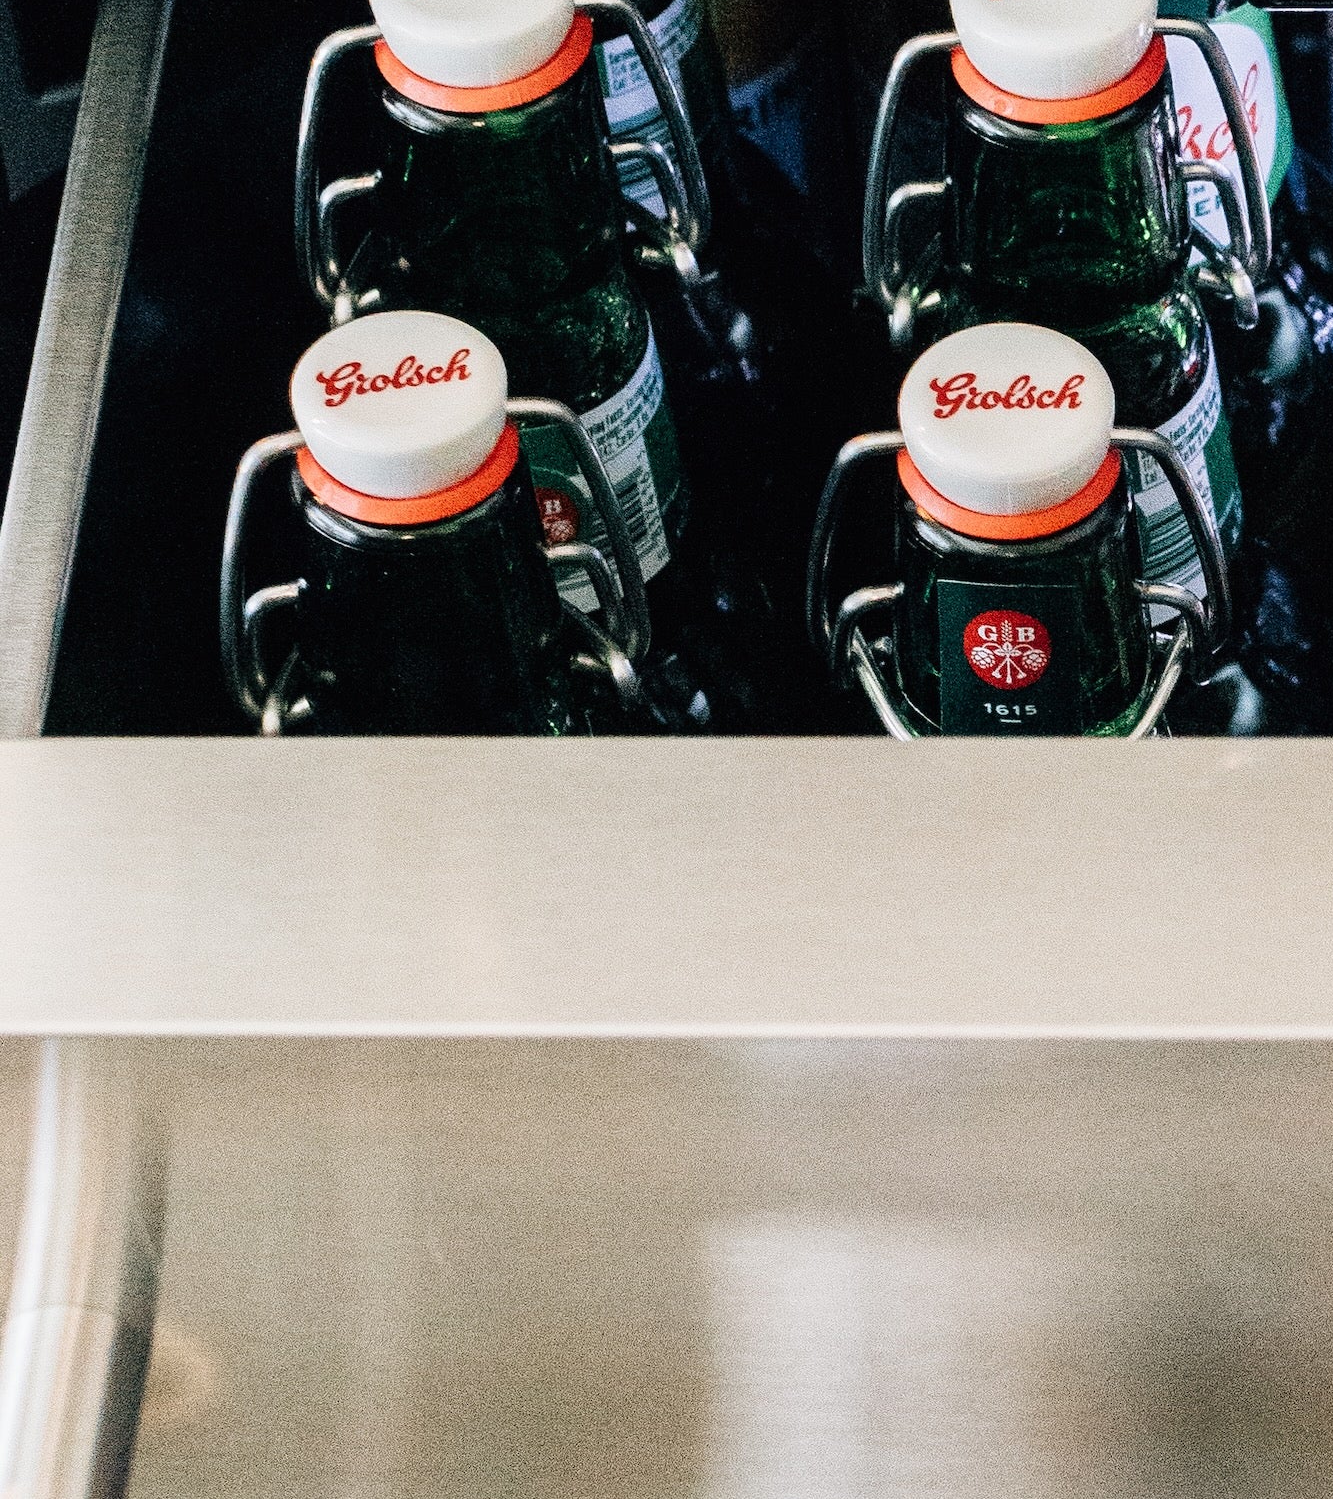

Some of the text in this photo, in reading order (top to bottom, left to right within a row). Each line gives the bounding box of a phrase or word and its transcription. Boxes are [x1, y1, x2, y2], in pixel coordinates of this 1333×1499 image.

[315, 348, 472, 408] Grolsch
[929, 372, 1086, 420] Grolsch
[976, 623, 1037, 643] G B
[983, 702, 1039, 718] 1615
